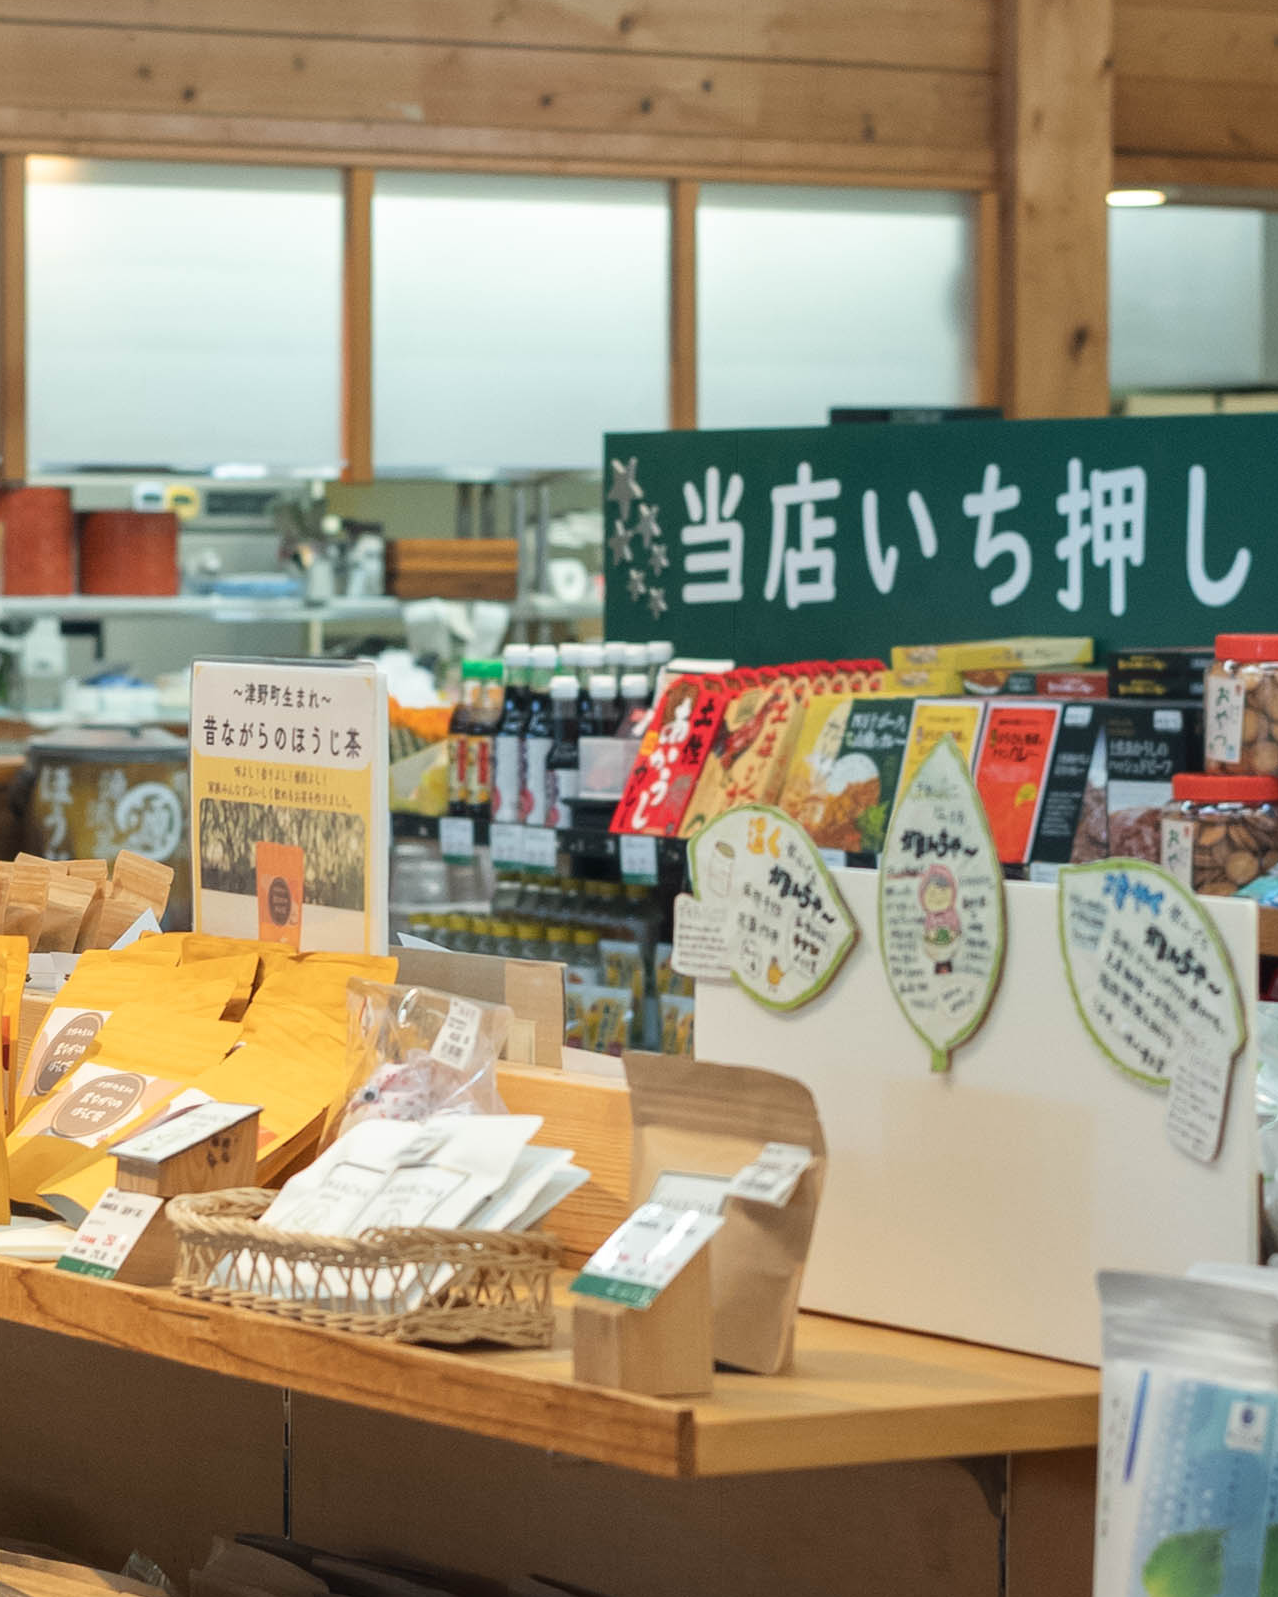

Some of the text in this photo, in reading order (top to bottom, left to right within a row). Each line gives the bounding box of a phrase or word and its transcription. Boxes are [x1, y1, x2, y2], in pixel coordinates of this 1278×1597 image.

[203, 715, 361, 759] 昔ながらのほうじ茶
